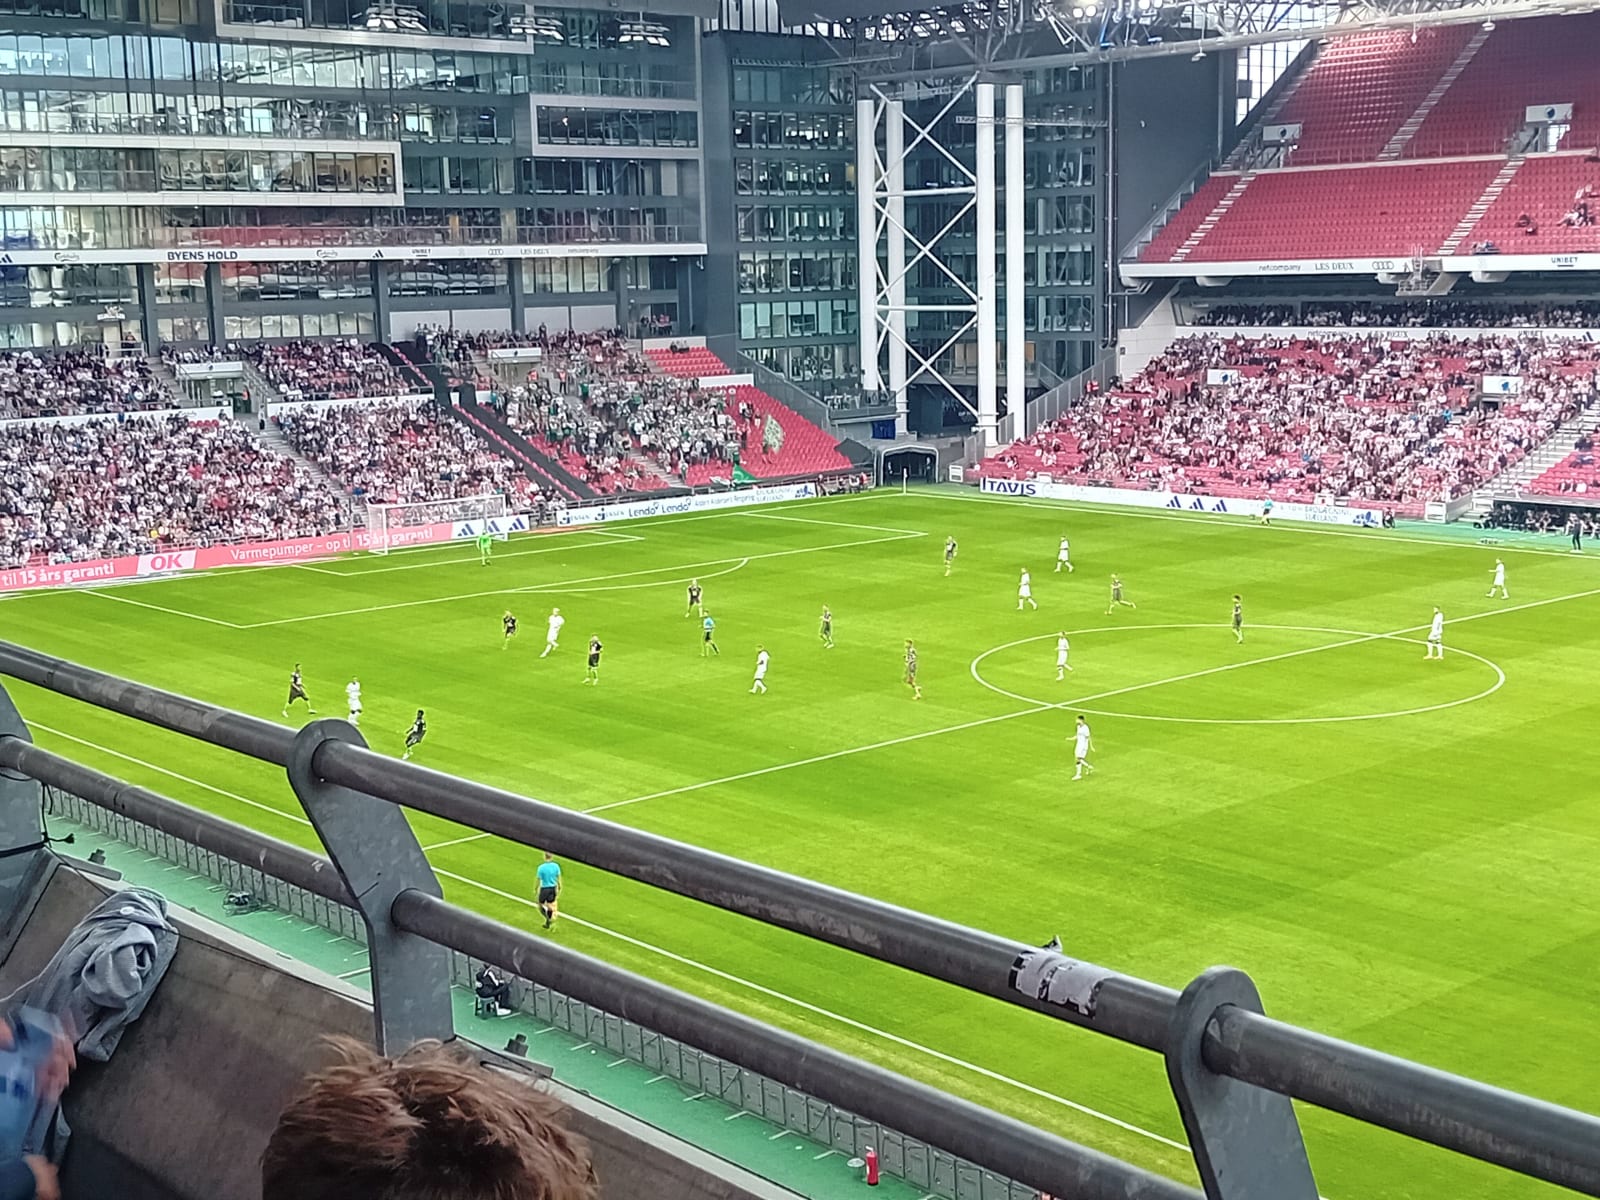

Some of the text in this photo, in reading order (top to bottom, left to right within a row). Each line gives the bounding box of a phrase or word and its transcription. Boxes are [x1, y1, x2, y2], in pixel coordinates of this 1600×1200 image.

[167, 250, 238, 260] BYENS HOLD
[1258, 263, 1301, 272] netcompany
[1315, 262, 1354, 271] LES DEUX
[628, 502, 656, 518] Lendo
[661, 499, 689, 515] Lendo
[231, 543, 314, 561] Varmepumper
[326, 540, 340, 553] op
[356, 534, 370, 547] 15
[391, 527, 433, 546] garanti
[150, 553, 183, 571] OK
[2, 562, 115, 586] til 15 års garanti
